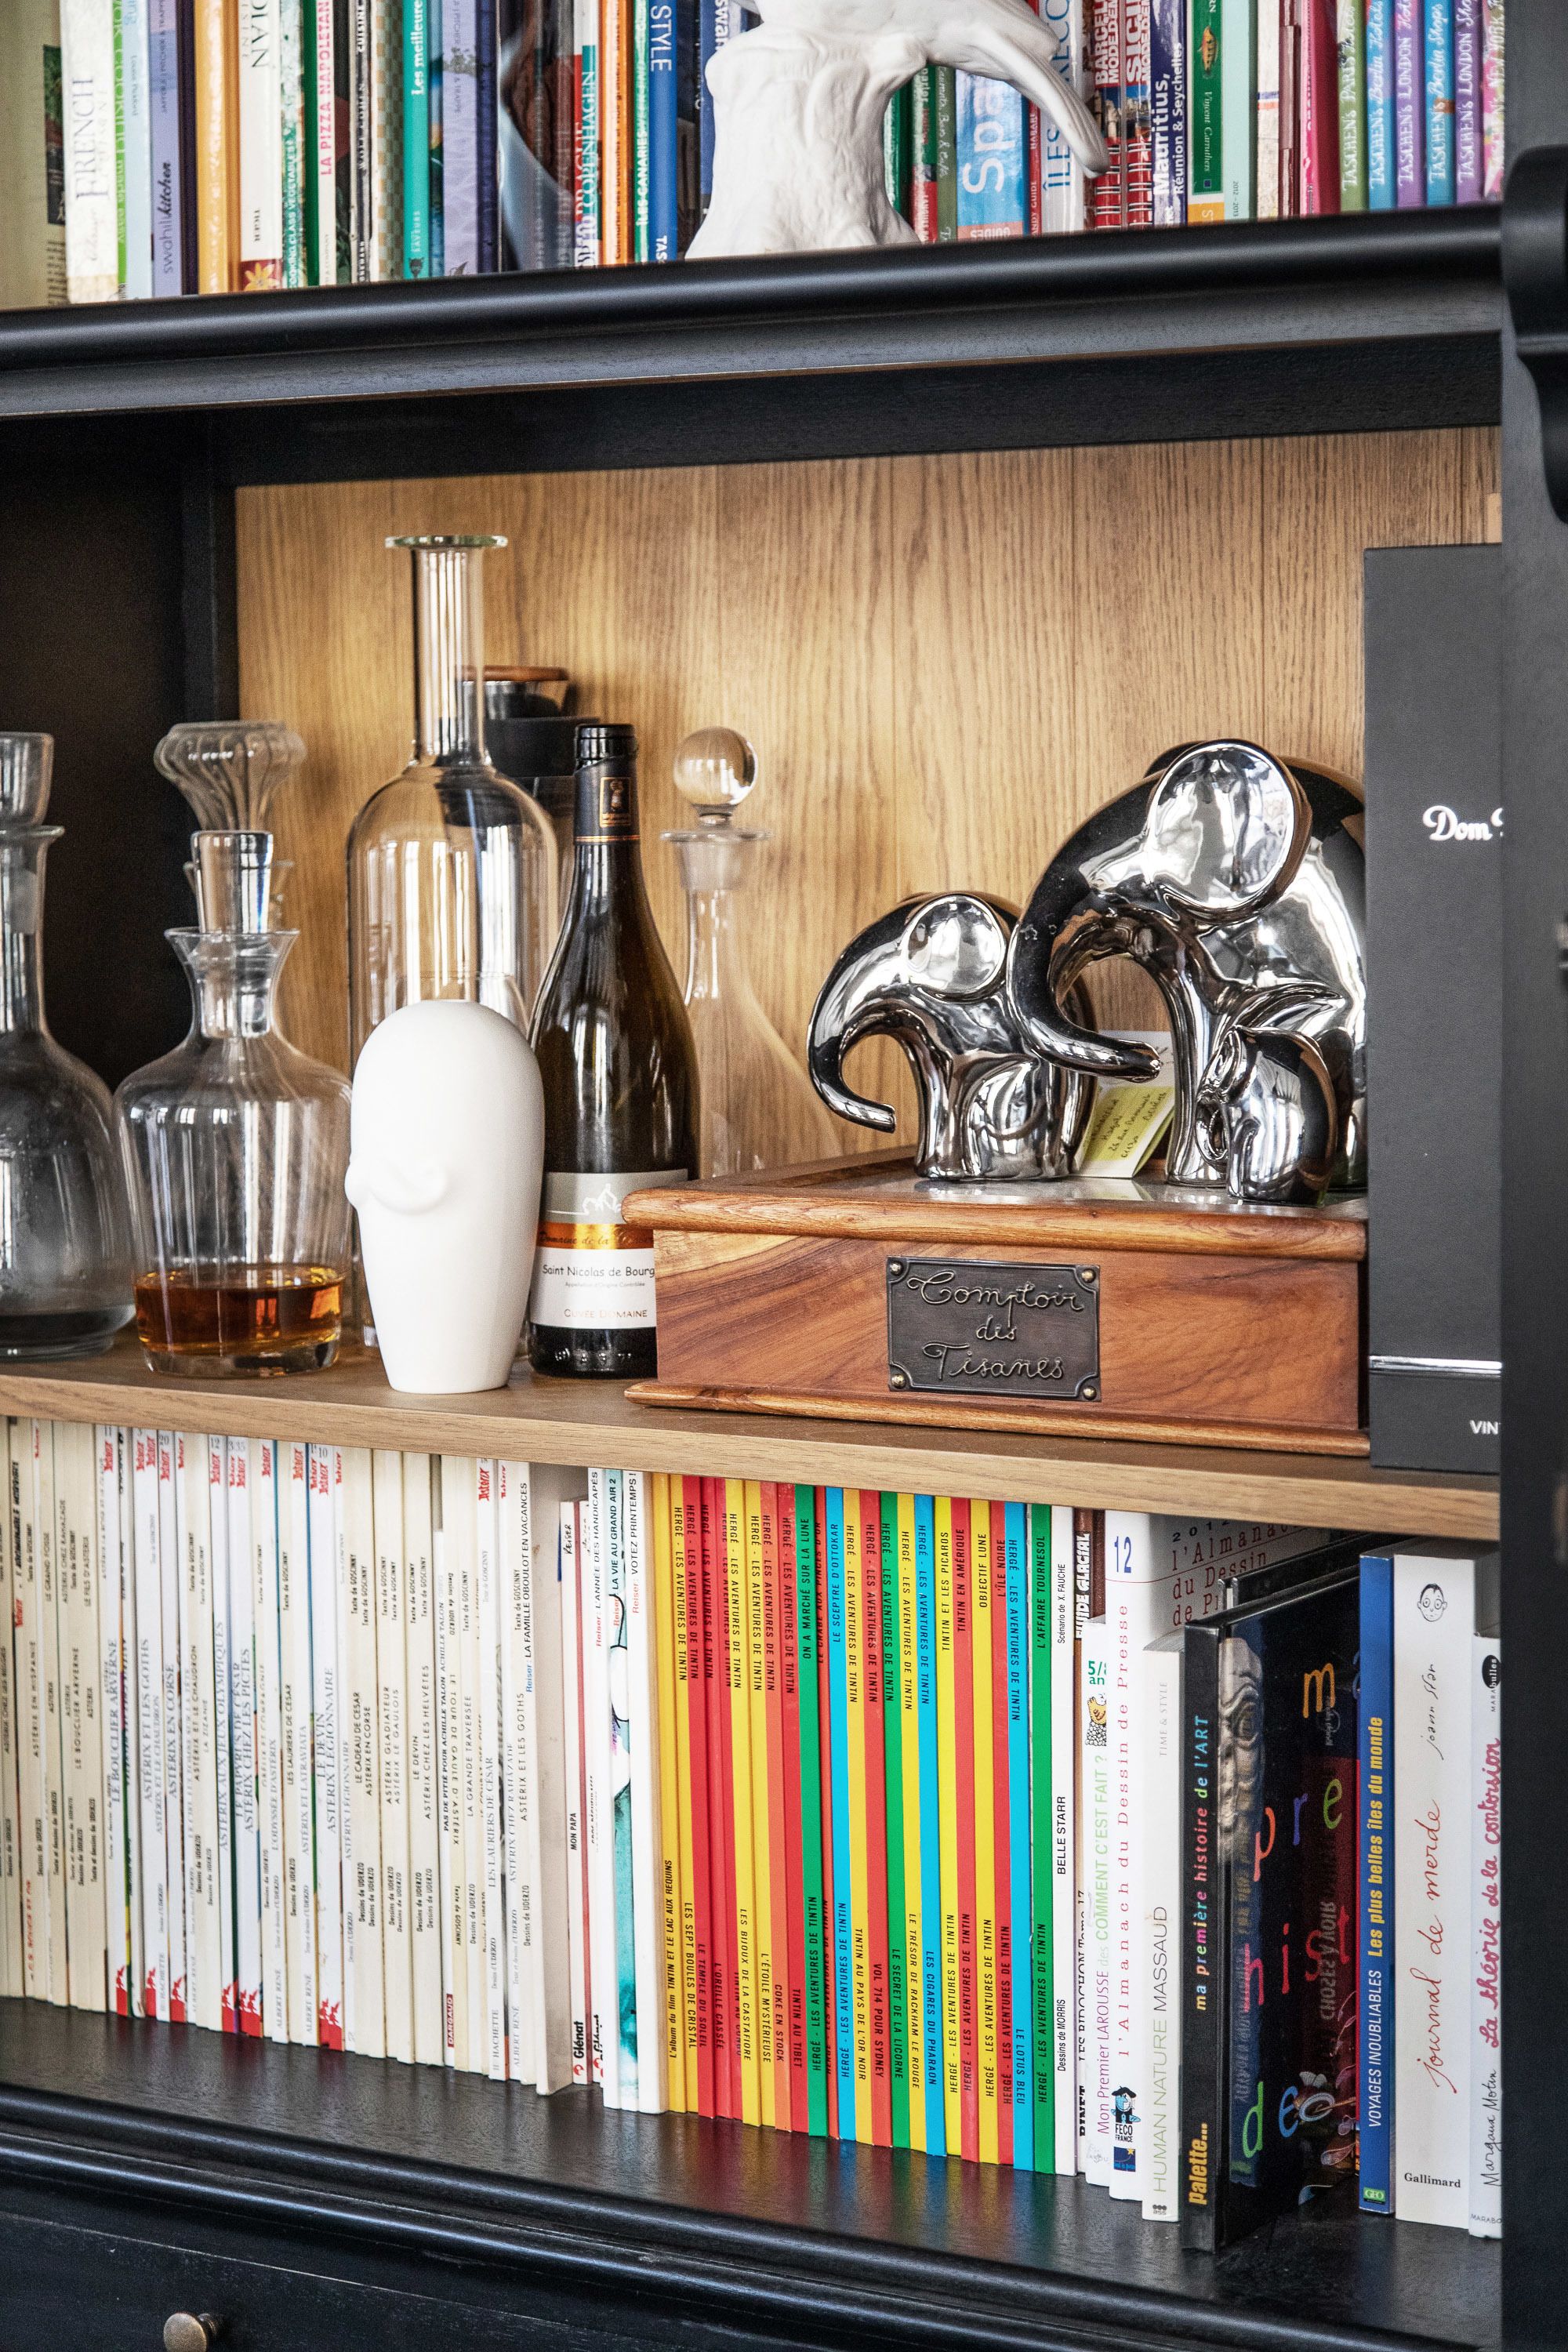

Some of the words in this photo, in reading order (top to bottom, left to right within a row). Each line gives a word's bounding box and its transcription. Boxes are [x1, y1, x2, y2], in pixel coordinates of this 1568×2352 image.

[651, 5, 672, 72] STYLE
[1427, 3, 1447, 45] Shops
[412, 71, 424, 95] Les
[1172, 42, 1185, 116] Seychelles
[1341, 56, 1356, 103] PARIS
[1369, 56, 1384, 104] Berlin
[1397, 37, 1412, 99] LONDON
[1426, 49, 1444, 98] Berlin
[1457, 32, 1473, 95] LONDON
[319, 102, 332, 149] PIZZA
[1174, 121, 1183, 131] &
[1203, 91, 1212, 123] Vincent
[71, 75, 109, 200] FRENCH
[582, 70, 596, 207] COPENHAGEN
[962, 87, 1014, 194] Spa
[1152, 73, 1171, 195] Mauritius,
[1203, 127, 1213, 172] Carruthers
[320, 158, 332, 176] LA
[1172, 136, 1185, 194] Réunion
[542, 1264, 564, 1278] Saint
[567, 1265, 604, 1277] Nicolas
[608, 1265, 622, 1277] de
[599, 1308, 648, 1318] DOMAINE
[906, 1269, 1085, 1330] Comptoir
[975, 1314, 1018, 1341] des
[922, 1340, 1065, 1381] Tisanes
[520, 1483, 528, 1536] VACANCES
[628, 1478, 637, 1537] PRINTEMPS
[521, 1538, 529, 1552] EN
[611, 1542, 618, 1557] AU
[800, 1519, 809, 1543] LUNE
[978, 1533, 986, 1558] LUNE
[630, 1541, 638, 1575] VOTEZ
[800, 1548, 810, 1559] LA
[1036, 1536, 1045, 1593] TOURNESOL
[1076, 1533, 1091, 1592] GLACIAL
[1113, 1536, 1132, 1574] 12
[521, 1554, 530, 1600] OBOULOT
[611, 1577, 619, 1590] LA
[801, 1564, 810, 1584] SUR
[978, 1563, 988, 1607] OBJECTIF
[1057, 1564, 1065, 1592] FAUCHE
[522, 1602, 531, 1642] FAMILLE
[801, 1589, 811, 1629] MARCHÉ
[1036, 1598, 1046, 1649] L'AFFAIRE
[1058, 1604, 1065, 1613] de
[1057, 1614, 1065, 1644] Scénario
[1117, 1606, 1129, 1690] Presse
[524, 1645, 532, 1658] LA
[803, 1646, 811, 1659] ON
[165, 1664, 175, 1711] CORSE
[241, 1648, 250, 1697] PICTES
[166, 1716, 176, 1734] EN
[241, 1701, 251, 1726] LES
[1117, 1704, 1128, 1730] de
[110, 1710, 120, 1780] BOUCLIER
[243, 1732, 252, 1769] CHEZ
[1193, 1715, 1208, 1768] l'ART
[1367, 1717, 1383, 1769] monde
[111, 1784, 121, 1802] LE
[1093, 1769, 1108, 1803] FAIT
[1117, 1742, 1128, 1826] Dessin
[1193, 1777, 1208, 1798] de
[1367, 1776, 1382, 1795] du
[1477, 1737, 1501, 1845] contorsion
[1056, 1796, 1065, 1835] STARR
[1093, 1806, 1108, 1855] C'EST
[1367, 1800, 1382, 1830] îles
[1057, 1838, 1066, 1875] BELLE
[1117, 1840, 1128, 1867] du
[1193, 1807, 1208, 1882] histoire
[1367, 1835, 1383, 1884] belles
[1414, 1798, 1440, 1901] merde
[664, 1860, 673, 1895] REQUINS
[1480, 1855, 1498, 1880] la
[665, 1899, 673, 1915] AUX
[1094, 1858, 1109, 1941] COMMENT
[1368, 1890, 1385, 1924] plus
[1481, 1883, 1499, 1907] de
[665, 1918, 674, 1933] LAC
[666, 1936, 674, 1947] LE
[1193, 1891, 1210, 1976] première
[1367, 1929, 1383, 1957] Les
[1417, 1915, 1444, 1955] de
[666, 1950, 675, 1960] ET
[1153, 1907, 1167, 2013] MASSAUD
[1476, 1917, 1501, 2009] théorie
[667, 1963, 676, 1990] TINTIN
[667, 1994, 676, 2009] film
[1095, 1970, 1109, 2040] LAROUSSE
[1196, 1984, 1207, 2010] ma
[668, 2013, 677, 2024] du
[1368, 1970, 1382, 2065] INOUBLIABLES
[1410, 1967, 1457, 2094] journal
[1479, 2016, 1499, 2049] La
[572, 2021, 584, 2059] Glénat
[668, 2027, 677, 2058] L'album
[1096, 2045, 1110, 2099] Premier
[1153, 2019, 1167, 2107] NATURE
[1368, 2069, 1382, 2128] VOYAGES
[1481, 2069, 1500, 2111] Motin
[1096, 2103, 1110, 2134] Mon
[1115, 2124, 1133, 2136] FECO
[1153, 2114, 1167, 2193] HUMAN
[1480, 2114, 1502, 2187] Margaux
[1403, 2172, 1461, 2188] Gallimard
